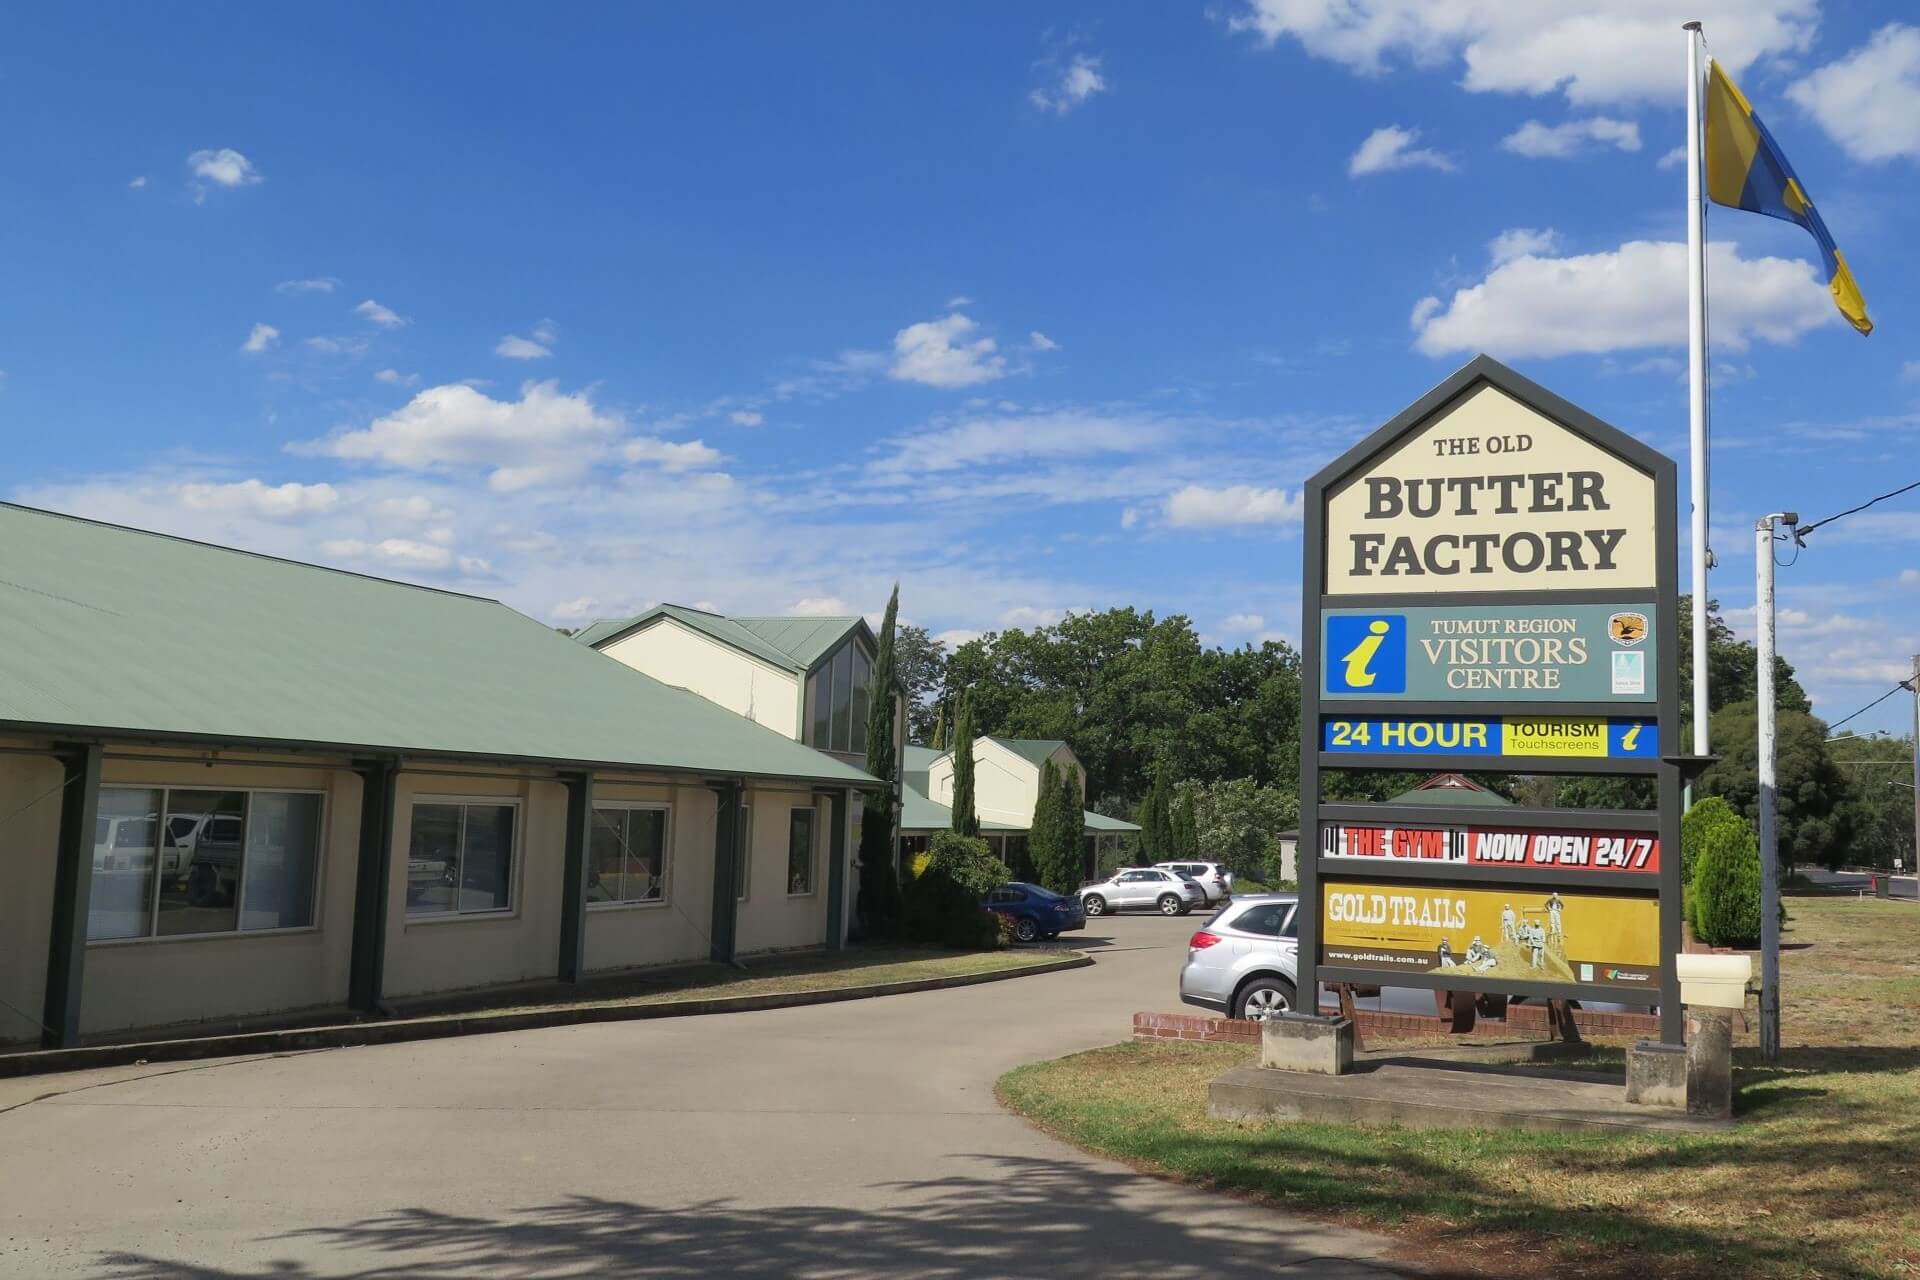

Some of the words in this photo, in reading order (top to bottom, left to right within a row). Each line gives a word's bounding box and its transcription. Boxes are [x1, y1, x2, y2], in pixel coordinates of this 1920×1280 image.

[1433, 437, 1480, 456] THE
[1486, 434, 1533, 454] OLD
[1363, 471, 1611, 520] BUTTER
[1348, 528, 1627, 576] FACTORY
[1431, 619, 1500, 634] TUMUT
[1504, 618, 1577, 634] REGION
[1420, 637, 1588, 665] VISITORS
[1447, 668, 1561, 689] CENTRE
[1331, 722, 1371, 747] 24
[1381, 722, 1488, 748] HOUR
[1511, 722, 1600, 738] TOURISM
[1511, 738, 1600, 750] Touchscreens
[1343, 827, 1386, 857] THE
[1391, 829, 1444, 859] GYM
[1476, 833, 1528, 863] NOW
[1532, 835, 1591, 866] OPEN
[1595, 838, 1654, 869] 24/7
[1328, 892, 1387, 924] GOLD
[1389, 895, 1466, 929] TRAILS
[1328, 951, 1429, 965] www.goldtrails.com.au
